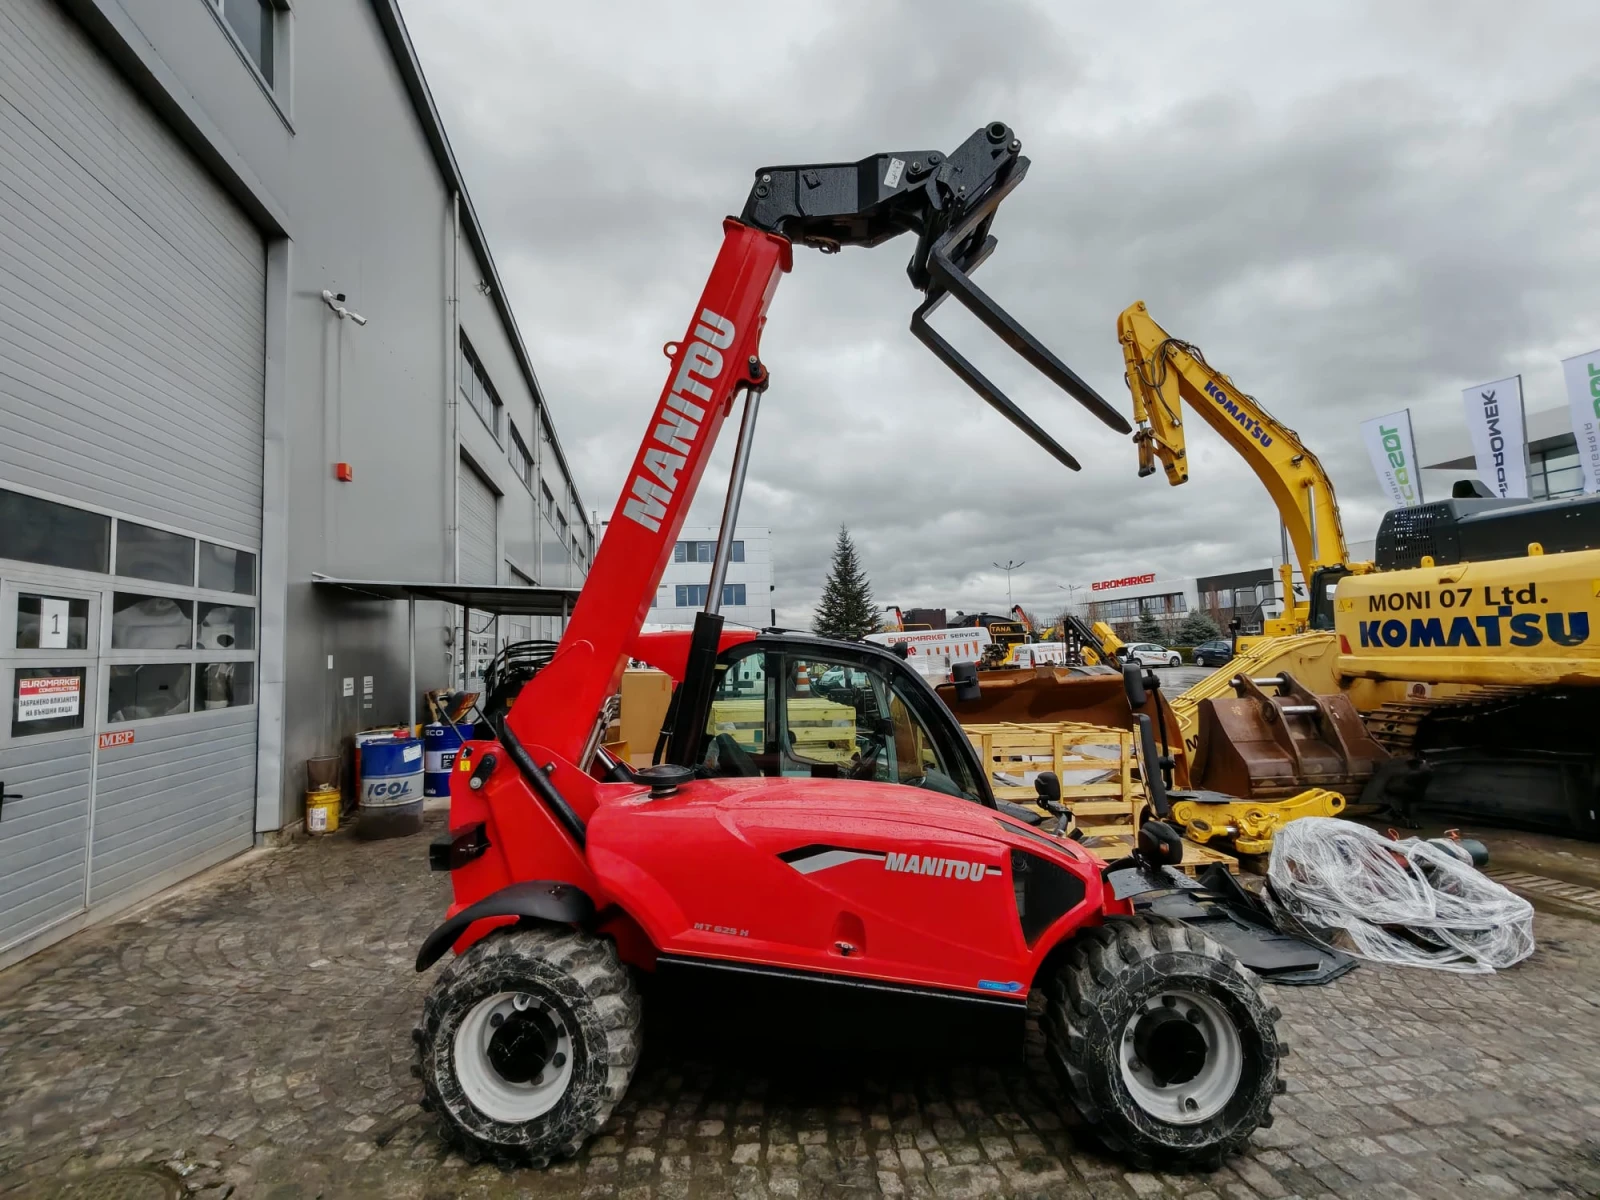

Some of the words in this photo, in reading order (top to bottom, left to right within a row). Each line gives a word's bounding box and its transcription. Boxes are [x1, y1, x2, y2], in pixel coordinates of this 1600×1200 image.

[622, 308, 735, 533] MANITOU
[1204, 380, 1273, 447] KOMATSU
[1092, 573, 1155, 591] EUROMARKET
[1369, 591, 1430, 612] MONI
[1439, 588, 1473, 607] 07
[1485, 582, 1548, 606] Ltd.
[51, 613, 61, 635] 1
[1359, 605, 1590, 648] KOMATSU
[888, 633, 947, 644] EUROMARKET
[950, 631, 980, 639] SERVICE
[21, 678, 79, 688] EUROMARKET
[884, 852, 986, 882] MANITOU
[694, 922, 712, 930] MT
[714, 925, 737, 935] 625
[739, 929, 749, 937] H
